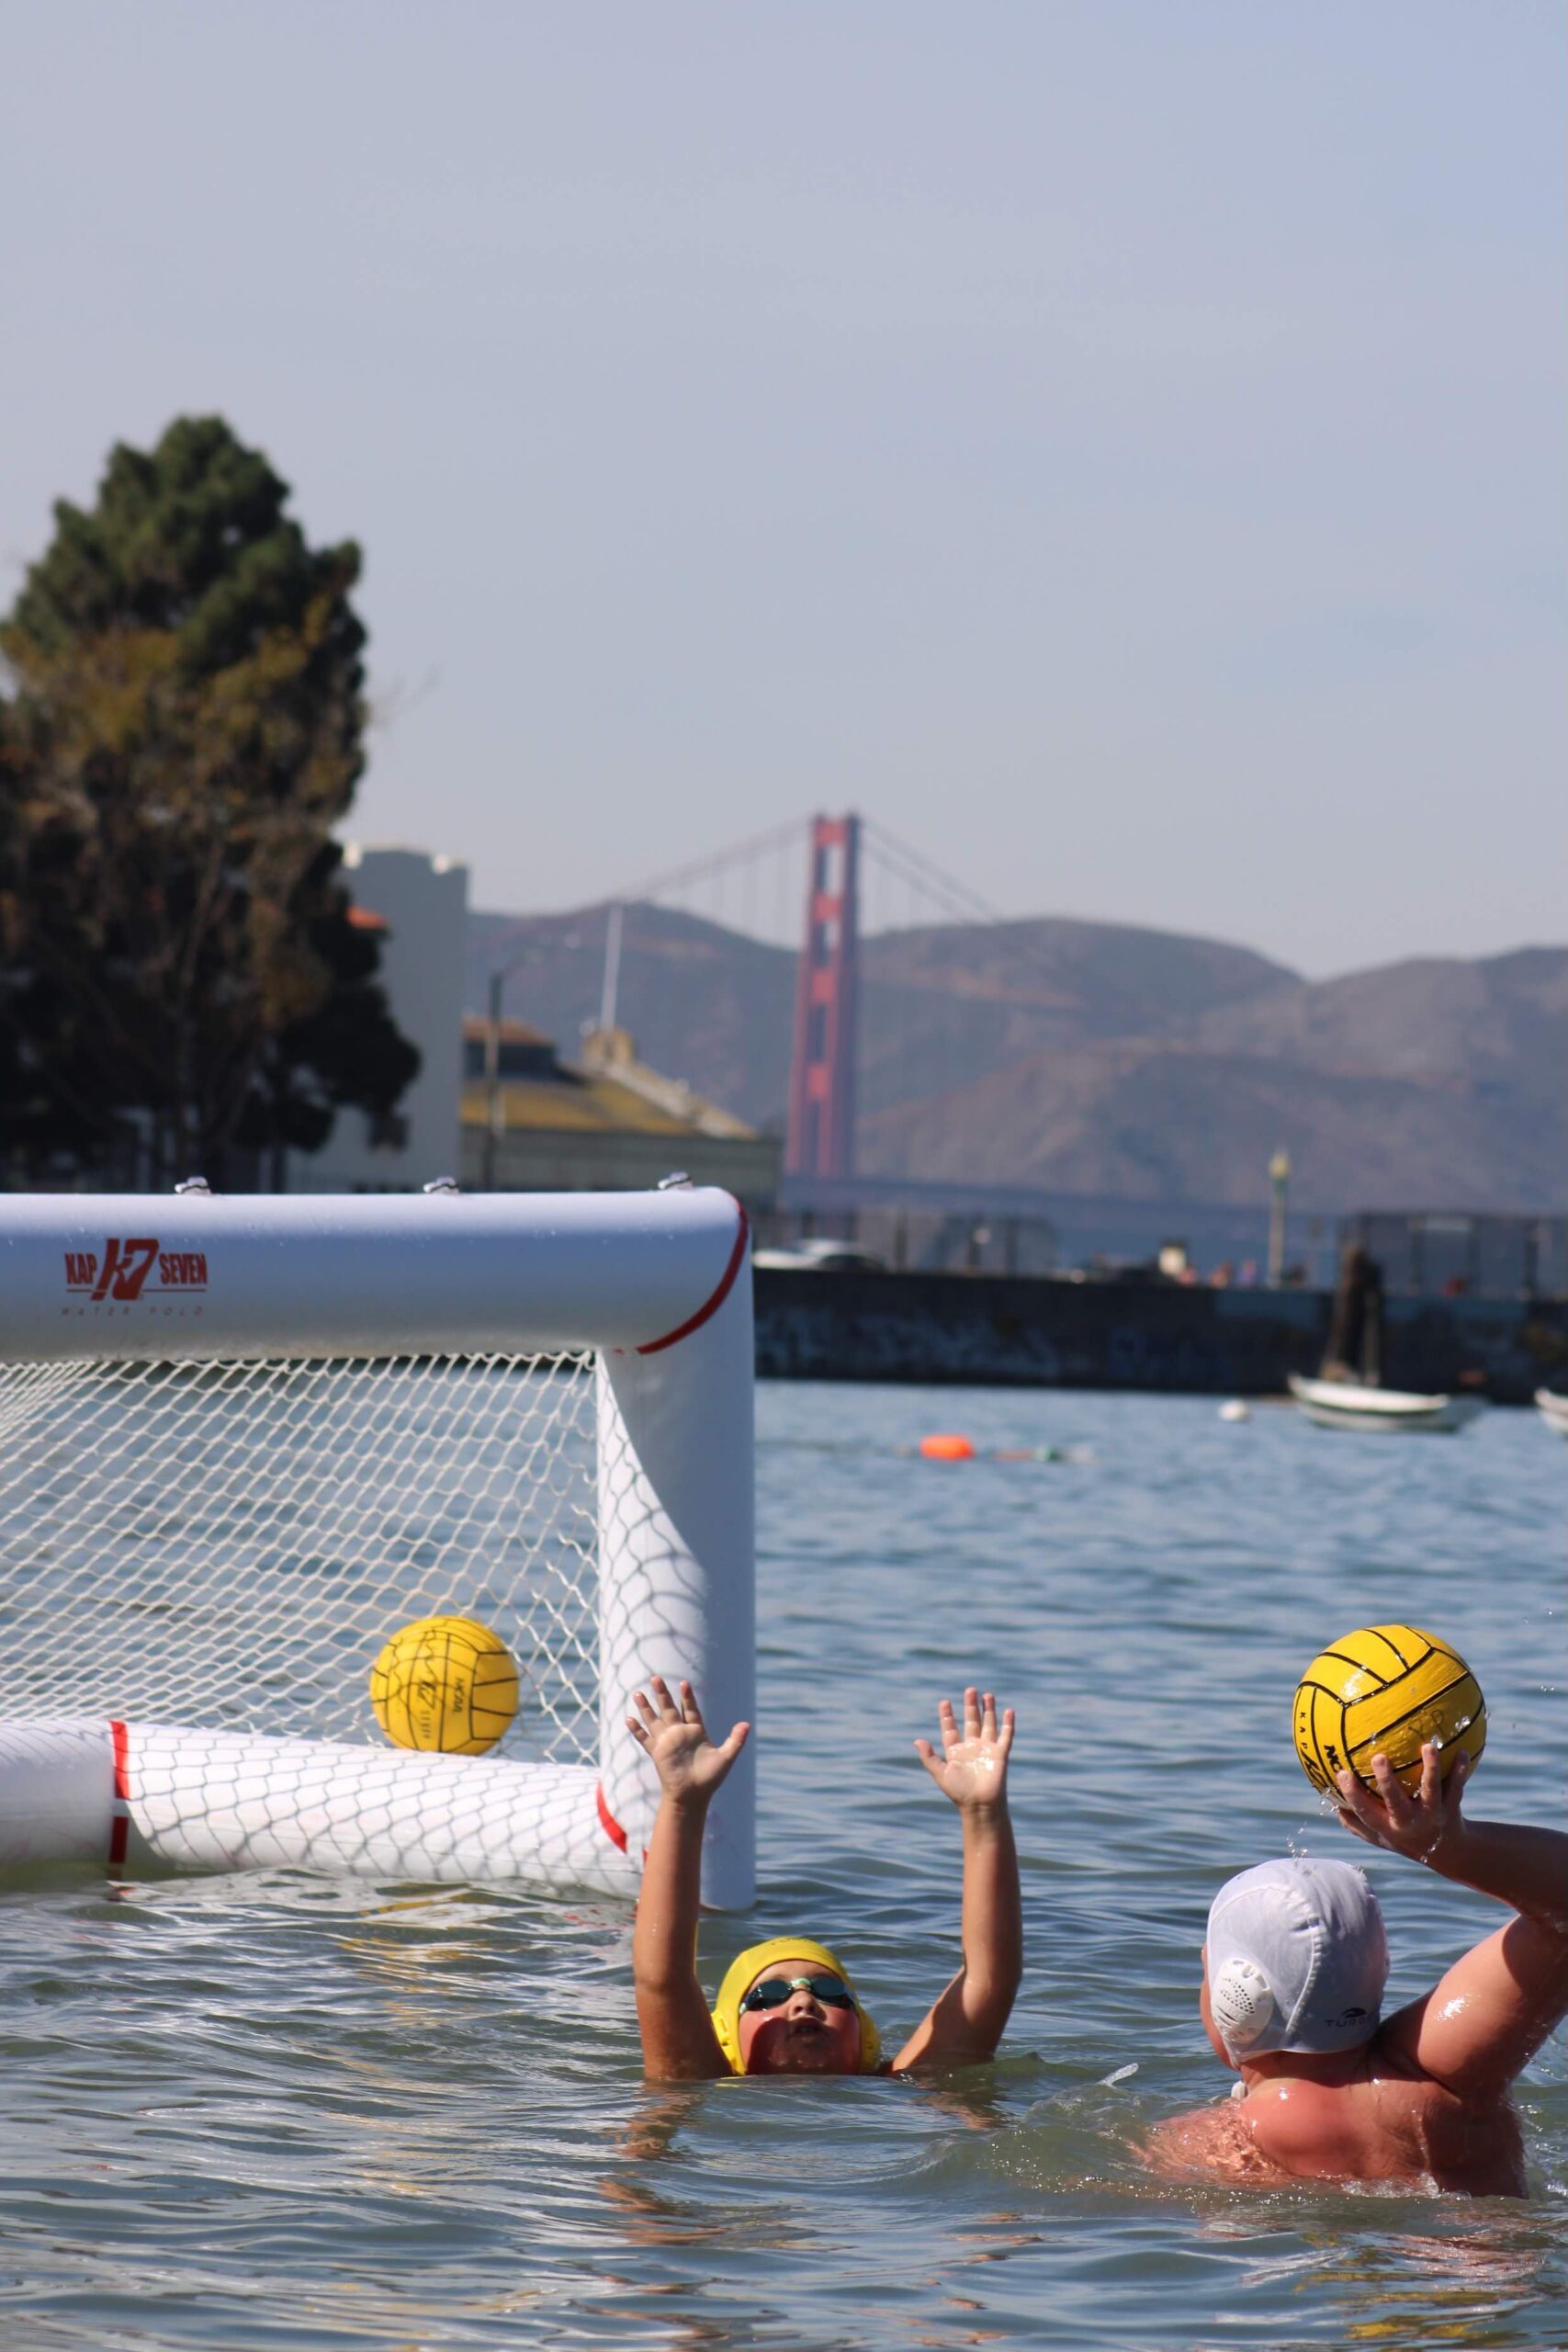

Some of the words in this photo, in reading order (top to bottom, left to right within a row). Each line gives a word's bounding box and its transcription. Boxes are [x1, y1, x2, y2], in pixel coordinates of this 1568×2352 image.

[64, 1253, 97, 1284] KAP
[90, 1238, 160, 1301] K7
[159, 1253, 208, 1284] SEVEN
[62, 1306, 130, 1317] WATER
[150, 1306, 204, 1317] POLO
[1300, 1712, 1308, 1750] KAP
[1324, 1744, 1343, 1772] NC
